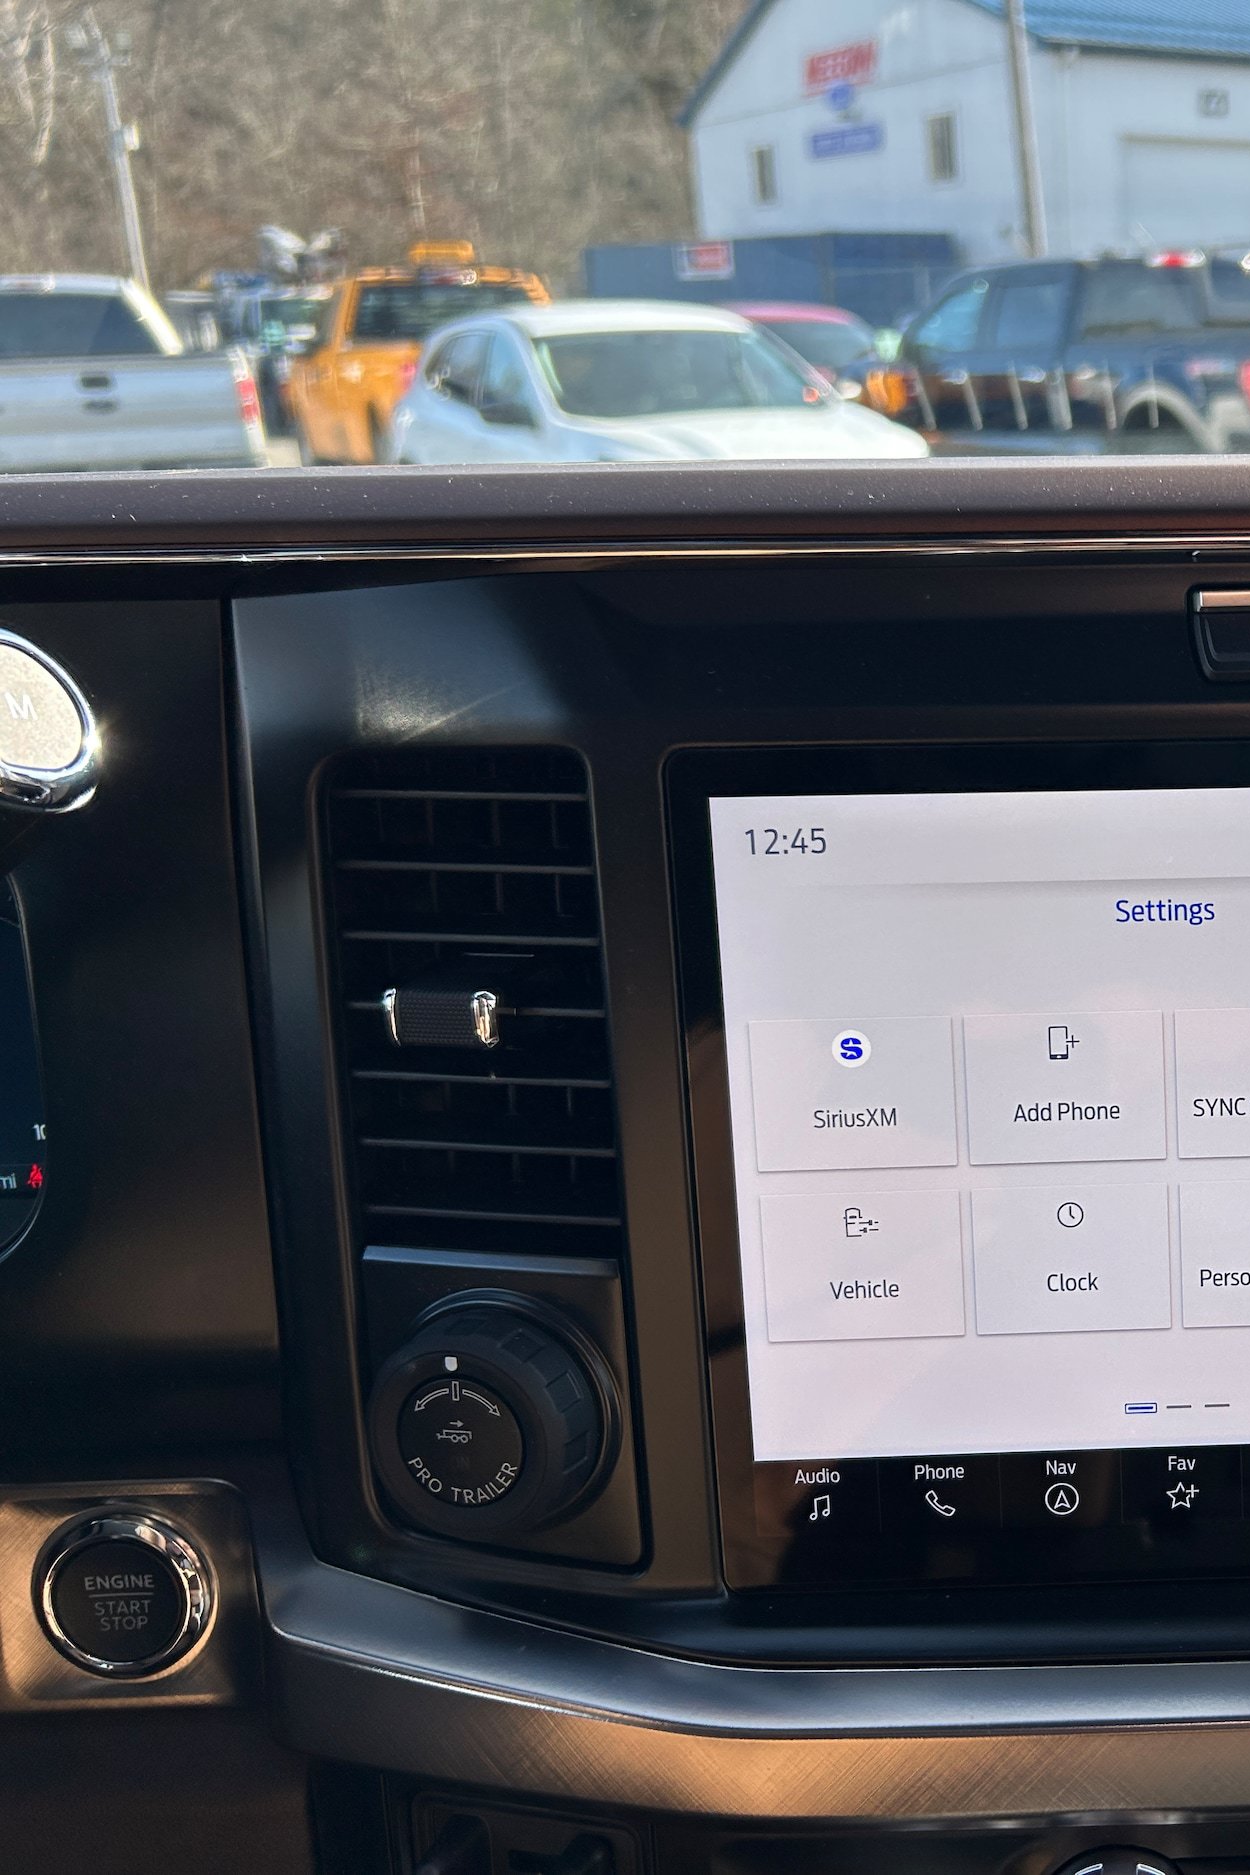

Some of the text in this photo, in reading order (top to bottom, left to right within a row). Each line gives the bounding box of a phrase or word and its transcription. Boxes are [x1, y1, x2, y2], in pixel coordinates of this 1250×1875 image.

[745, 827, 827, 855] 12:45
[1115, 898, 1215, 926] Settings
[1013, 1101, 1120, 1123] Add Phone
[1193, 1097, 1247, 1117] SYNC
[813, 1107, 897, 1129] SiriusXM
[829, 1279, 900, 1300] Vehicle
[1047, 1272, 1099, 1292] Clock
[914, 1463, 965, 1480] Phone
[1045, 1459, 1077, 1476] Nav
[1168, 1455, 1196, 1471] Fav
[408, 1457, 518, 1504] PRO TRAILER
[794, 1467, 841, 1485] Audio
[84, 1574, 155, 1591] ENGINE
[94, 1600, 151, 1616] START
[100, 1616, 148, 1631] STOP
